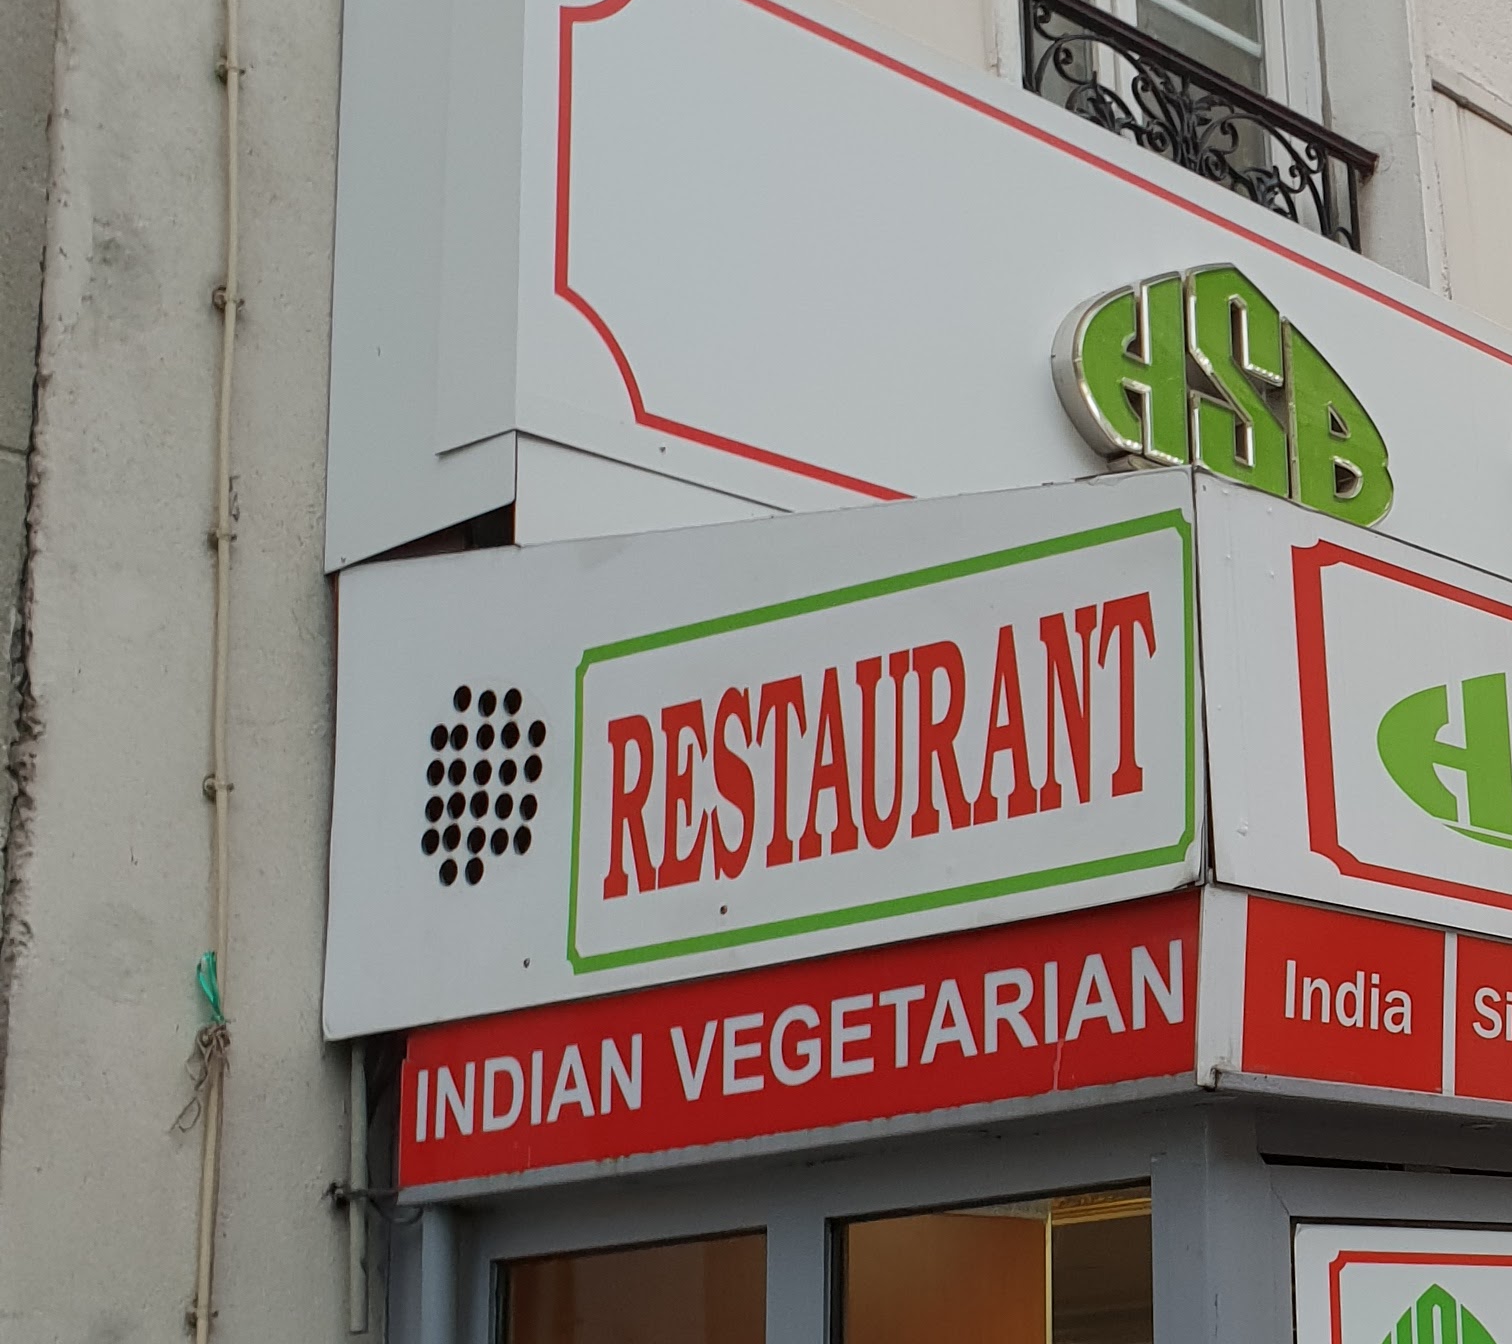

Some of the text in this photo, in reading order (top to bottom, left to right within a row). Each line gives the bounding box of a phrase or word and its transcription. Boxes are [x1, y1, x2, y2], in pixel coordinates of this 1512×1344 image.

[603, 591, 1156, 901] RESTAURANT
[414, 938, 1185, 1144] INDIAN VEGETARIAN
[1284, 959, 1413, 1035] India
